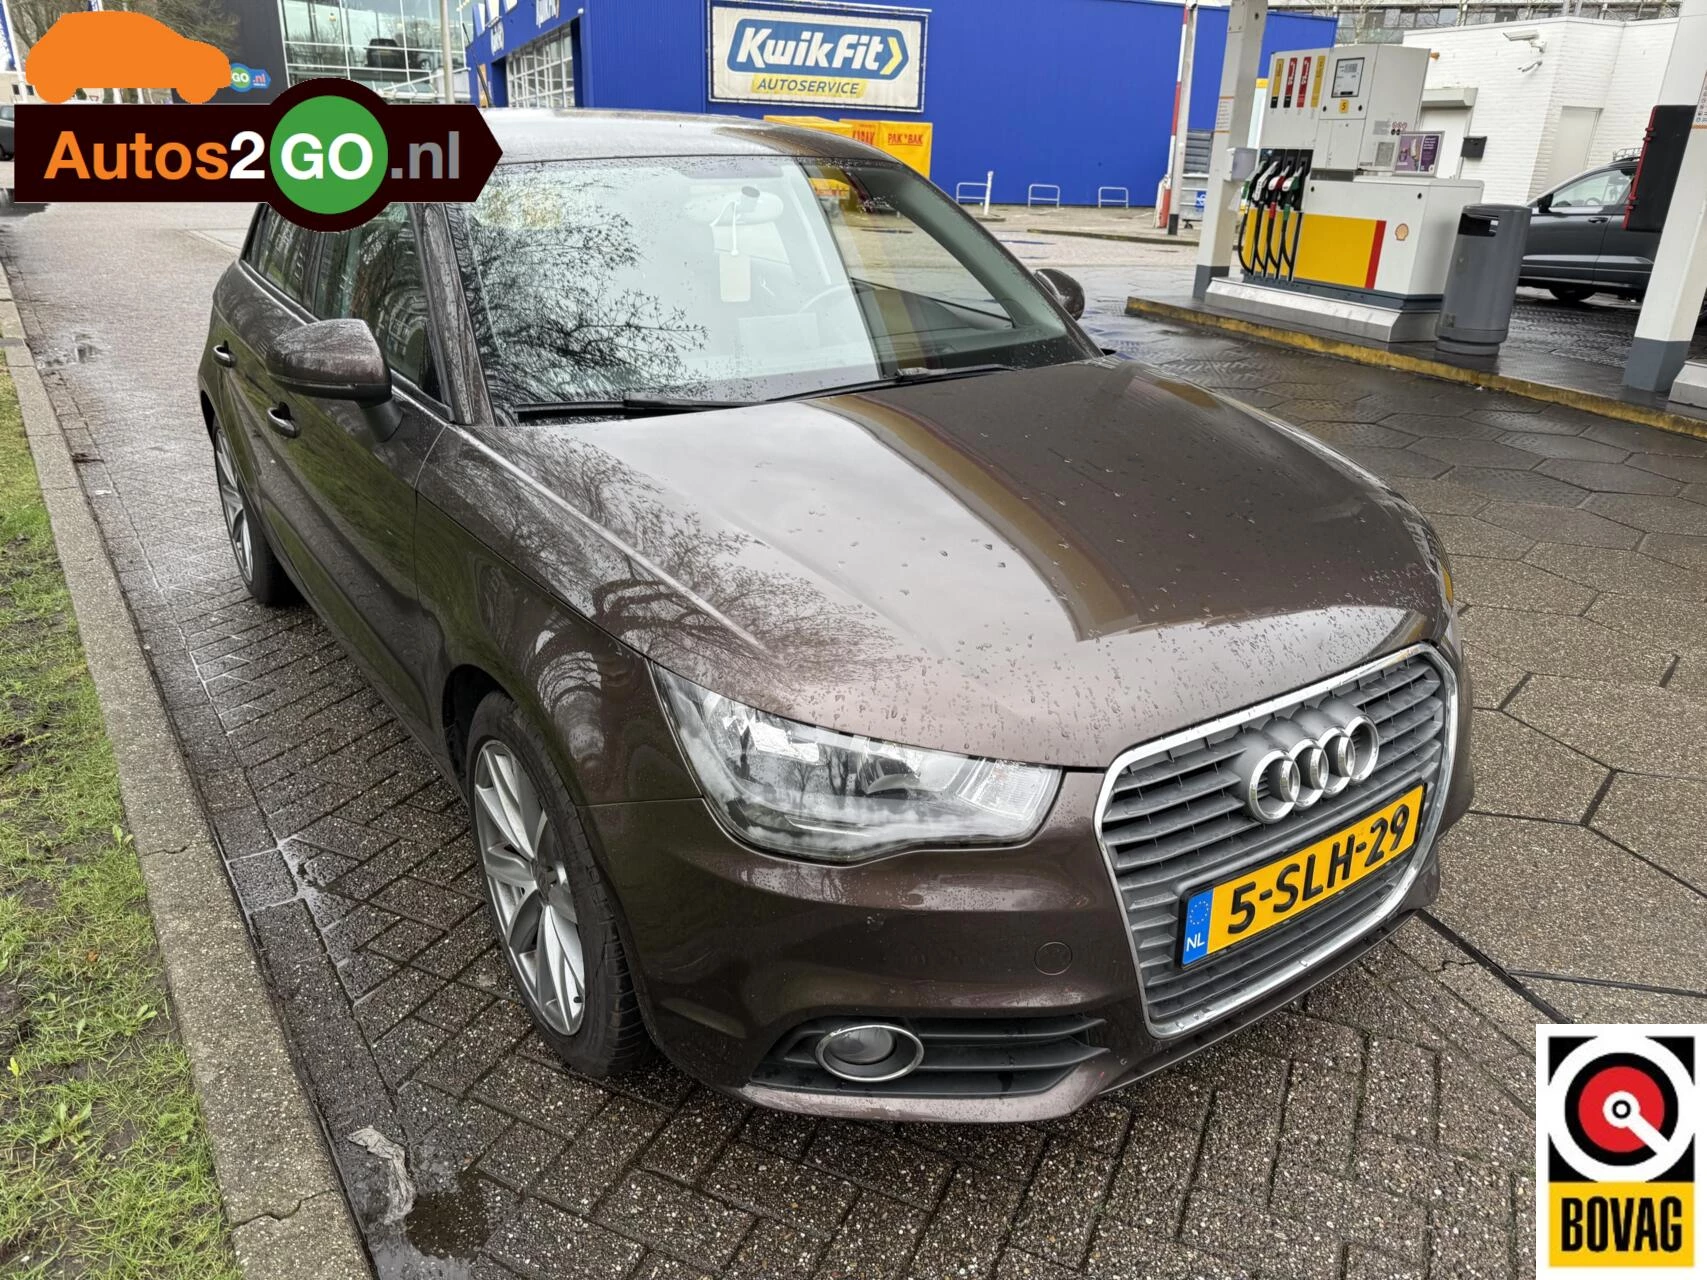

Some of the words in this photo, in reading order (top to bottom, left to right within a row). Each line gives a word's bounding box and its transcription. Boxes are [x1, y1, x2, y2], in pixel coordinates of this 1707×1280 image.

[757, 78, 860, 95] AUTOSERVICE
[1227, 804, 1410, 934] 5-SLH-29
[1186, 933, 1205, 951] NL
